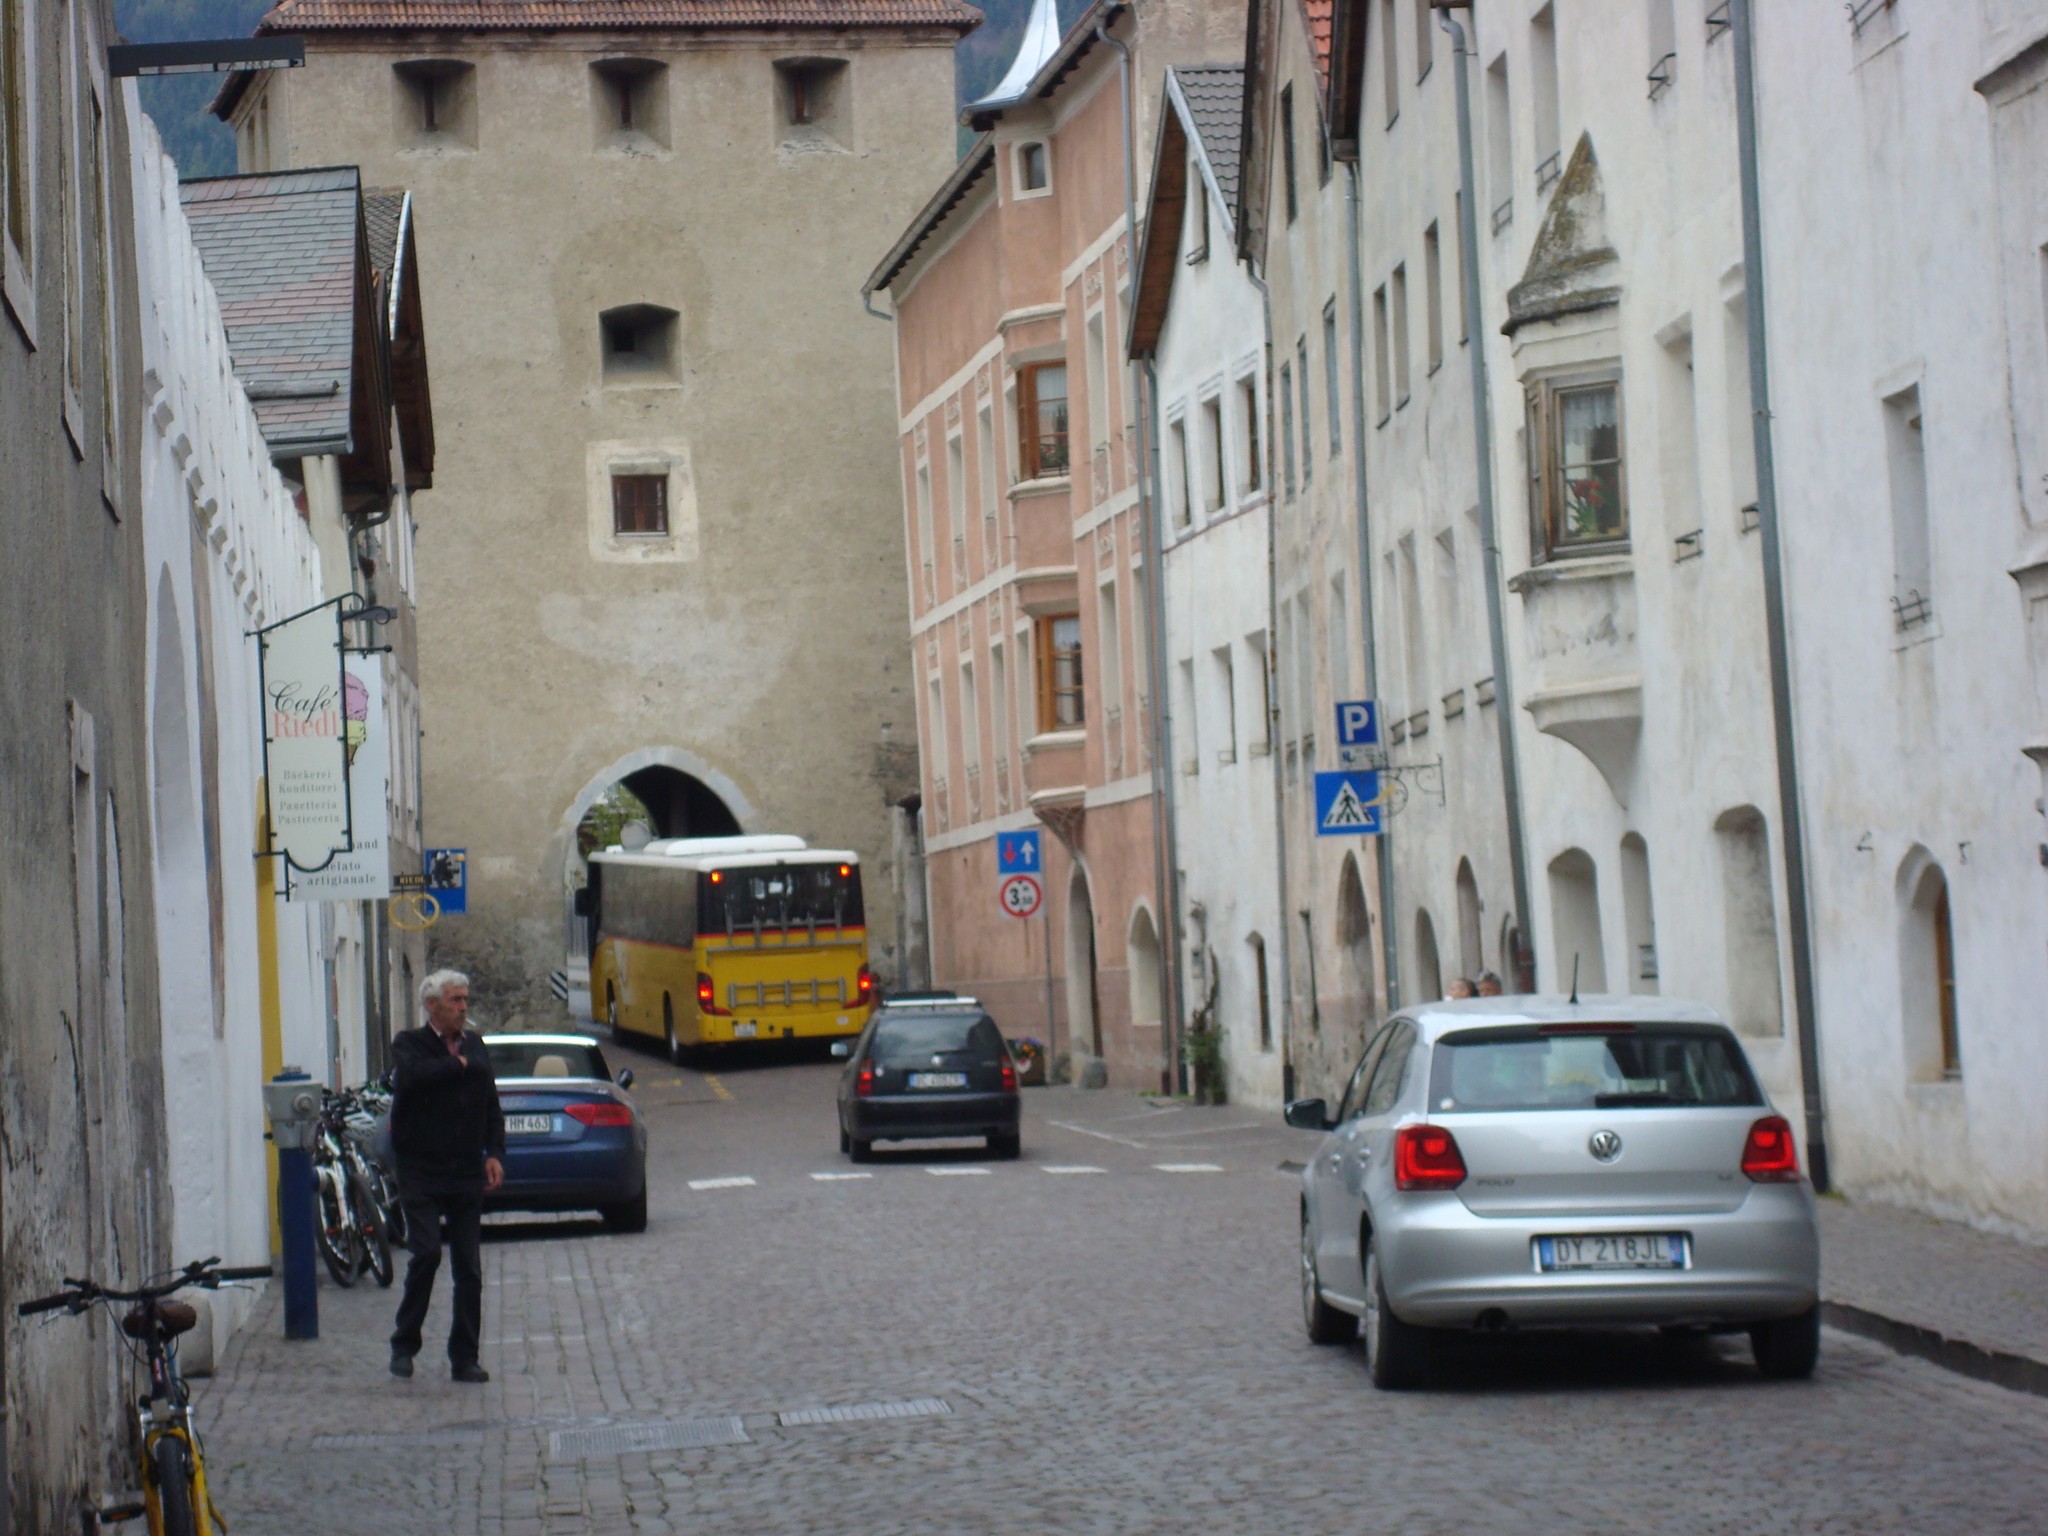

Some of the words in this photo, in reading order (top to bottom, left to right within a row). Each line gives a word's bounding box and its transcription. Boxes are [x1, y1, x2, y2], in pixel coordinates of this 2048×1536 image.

[268, 680, 338, 723] Café
[273, 710, 338, 737] Riedl
[1343, 705, 1369, 742] P
[278, 783, 337, 793] Konditorei
[278, 814, 339, 824] Pasticceria
[307, 873, 376, 887] artigianale
